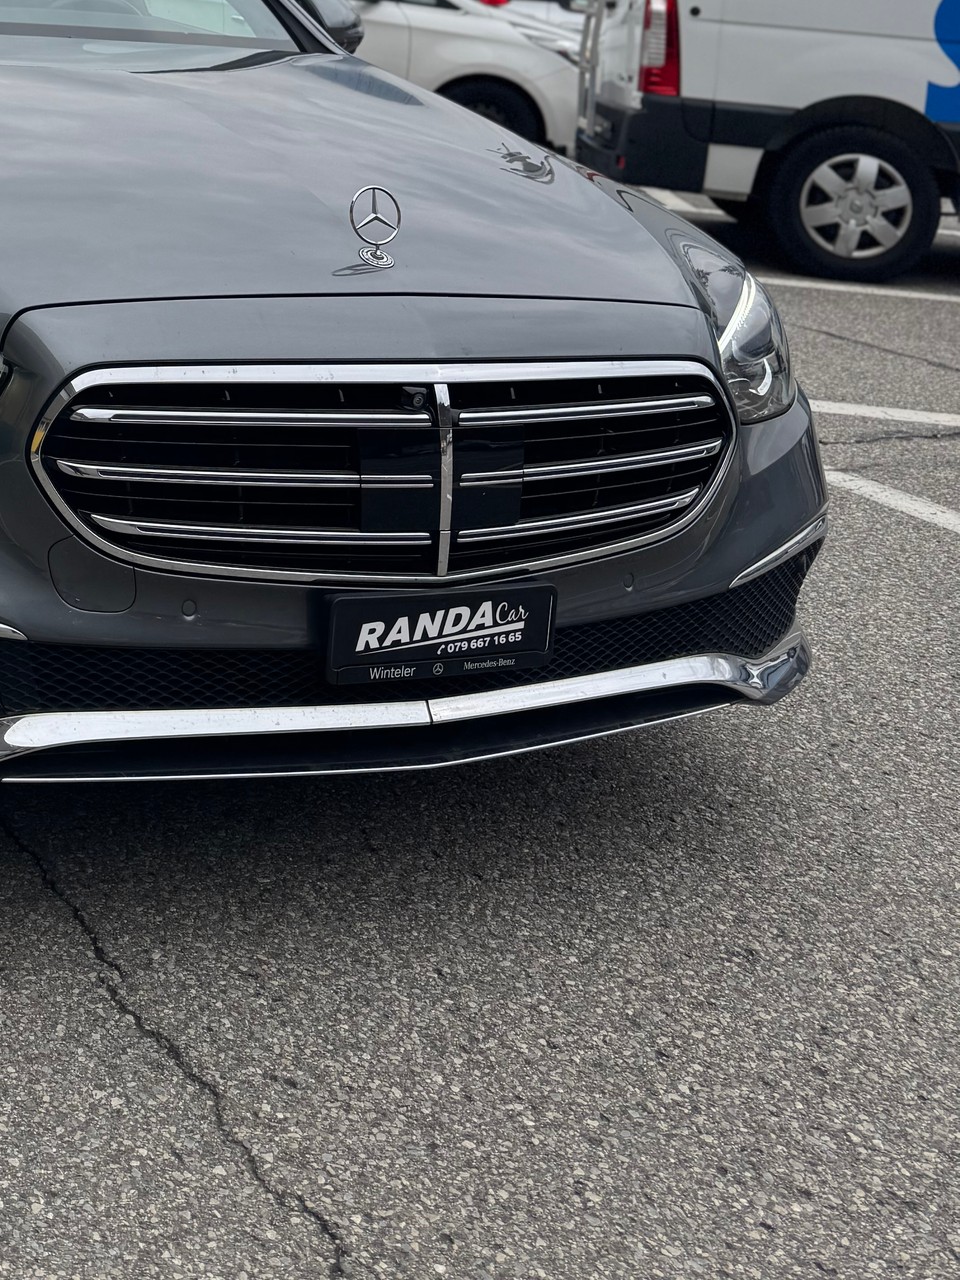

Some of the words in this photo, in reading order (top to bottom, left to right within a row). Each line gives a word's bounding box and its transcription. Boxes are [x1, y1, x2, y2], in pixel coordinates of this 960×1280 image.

[355, 601, 493, 652] RANDA
[495, 602, 529, 625] Car
[447, 641, 469, 653] 079
[470, 637, 490, 649] 667
[493, 634, 507, 645] 16
[508, 631, 522, 643] 65
[369, 666, 416, 680] Winteler
[463, 658, 515, 670] Mercedes-Benz
